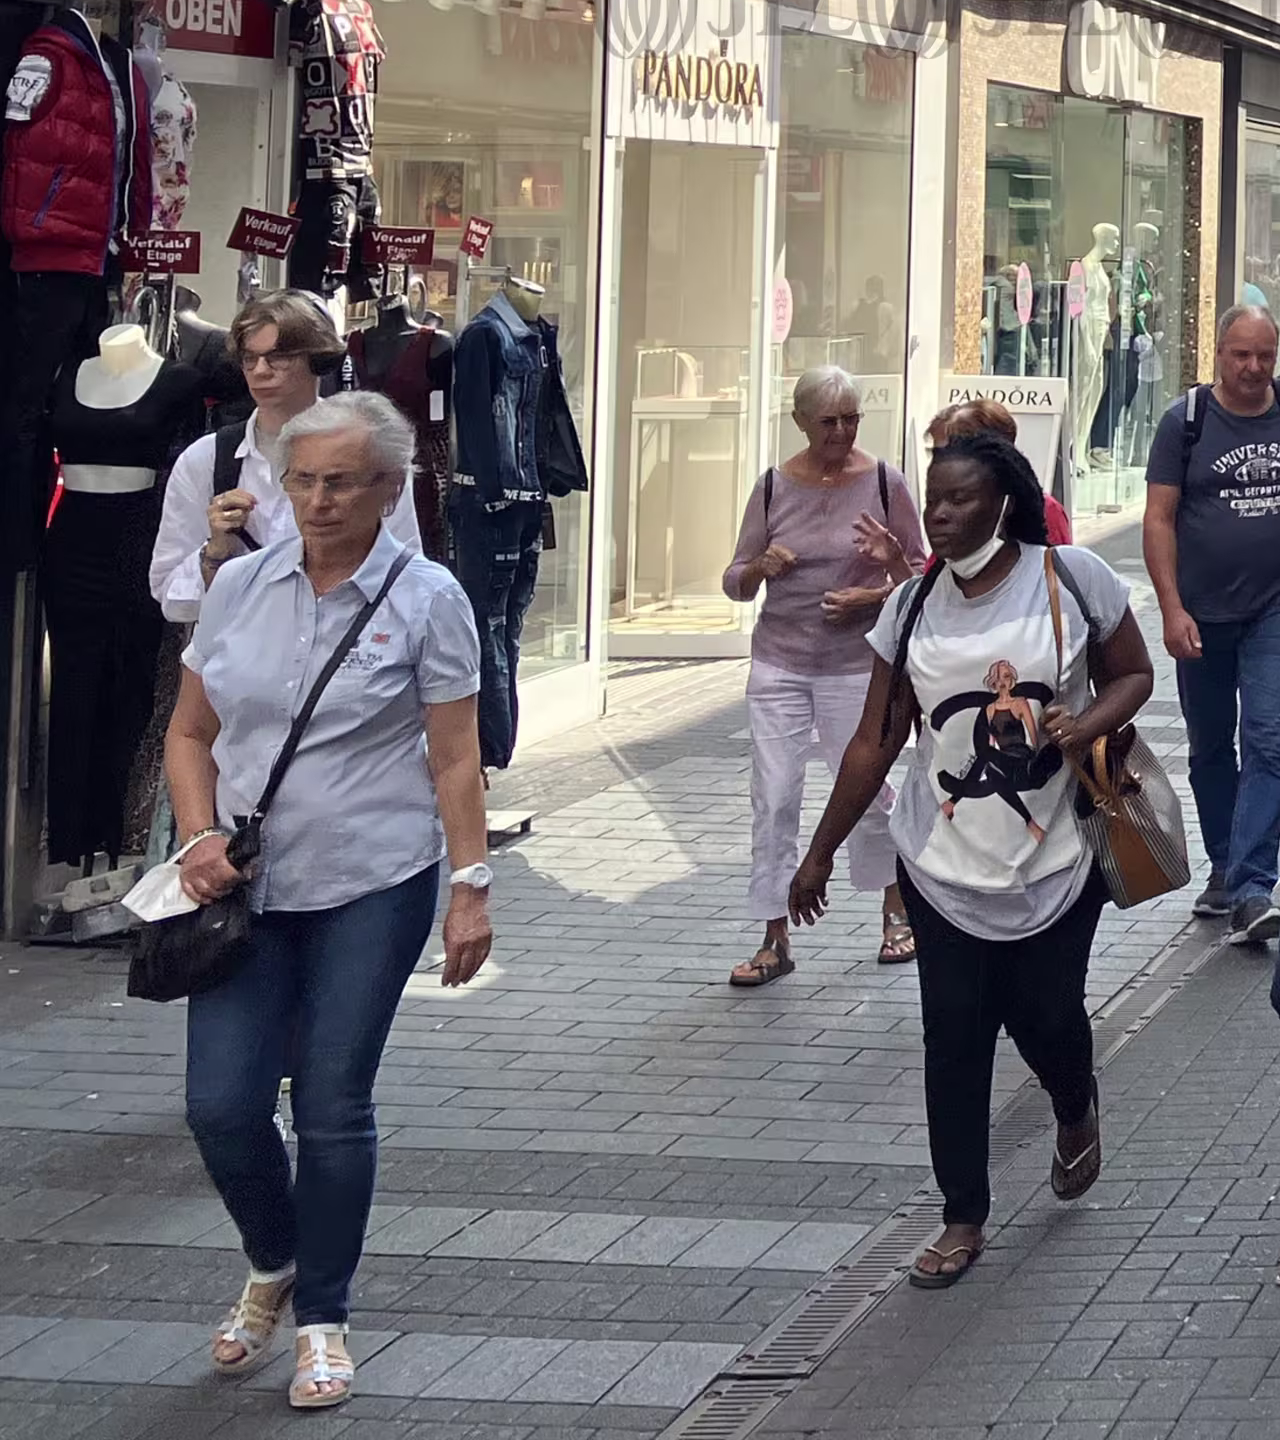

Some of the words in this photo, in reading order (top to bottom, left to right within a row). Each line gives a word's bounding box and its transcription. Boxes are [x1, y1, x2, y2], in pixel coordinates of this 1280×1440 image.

[1070, 0, 1166, 106] ONLY
[642, 44, 764, 108] PANDORA
[244, 213, 292, 237] Verkauf
[146, 249, 183, 262] Etage
[948, 387, 1053, 406] PANDORA
